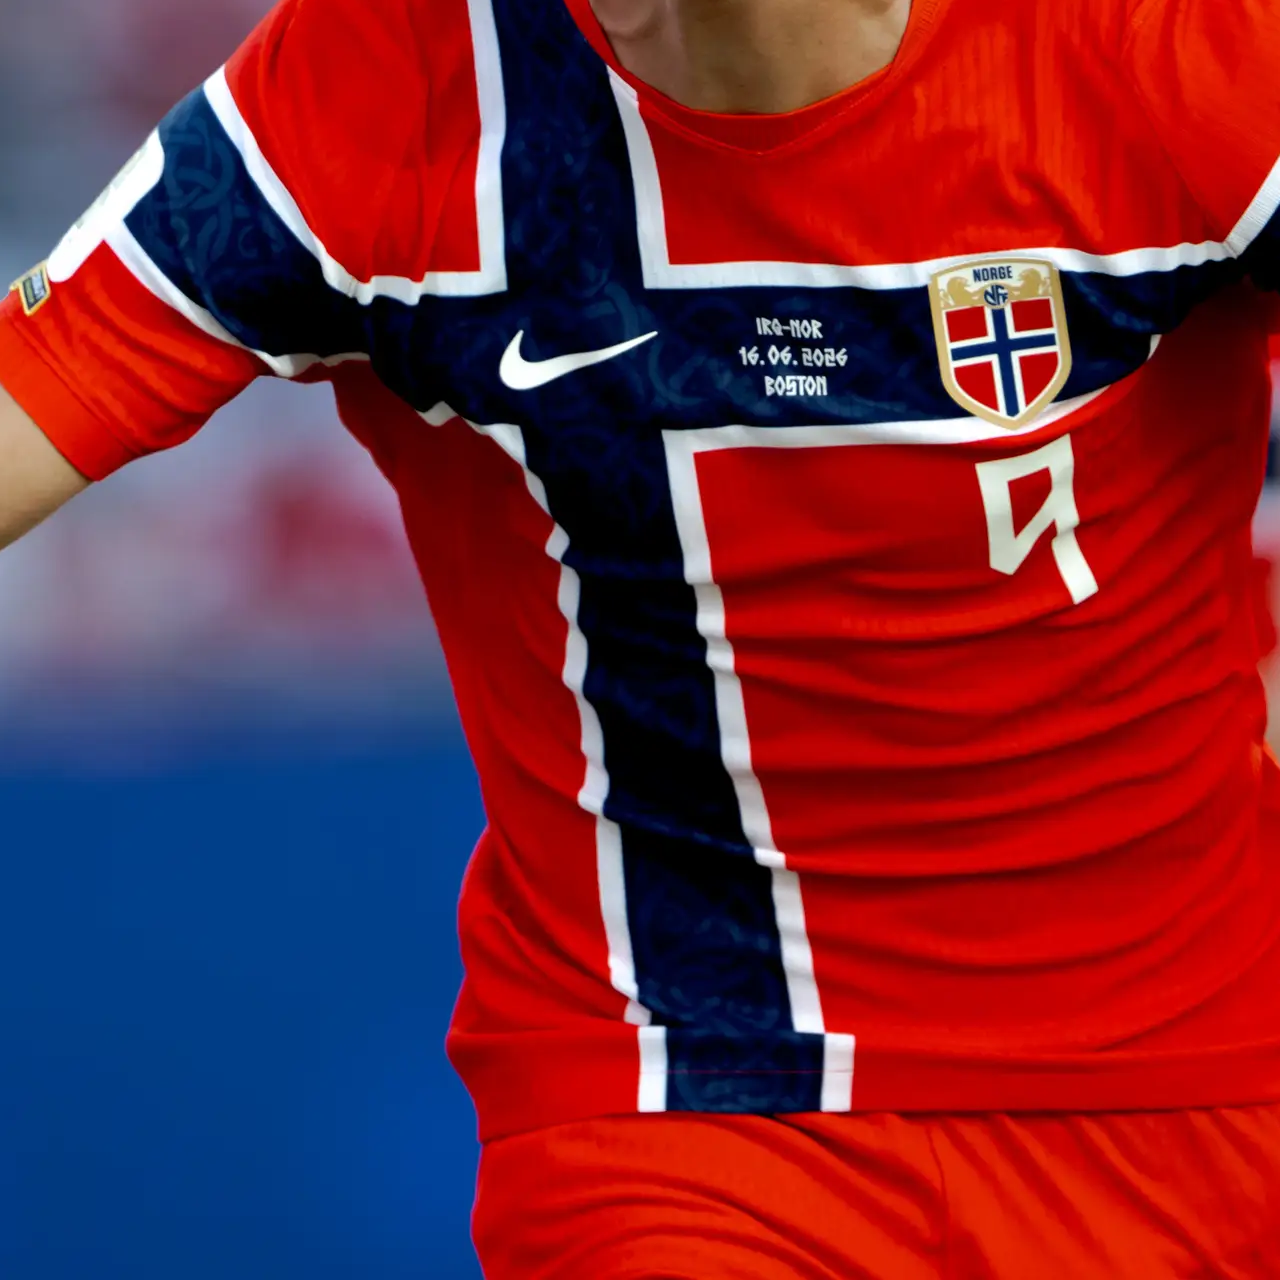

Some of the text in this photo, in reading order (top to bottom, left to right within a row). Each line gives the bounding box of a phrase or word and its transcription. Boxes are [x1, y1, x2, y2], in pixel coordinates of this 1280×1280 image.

[972, 265, 1013, 282] NORGE
[756, 317, 823, 339] IRQ-NOR
[739, 344, 848, 367] 16.06.2026
[764, 375, 828, 396] BOSTON
[975, 433, 1099, 605] 9
